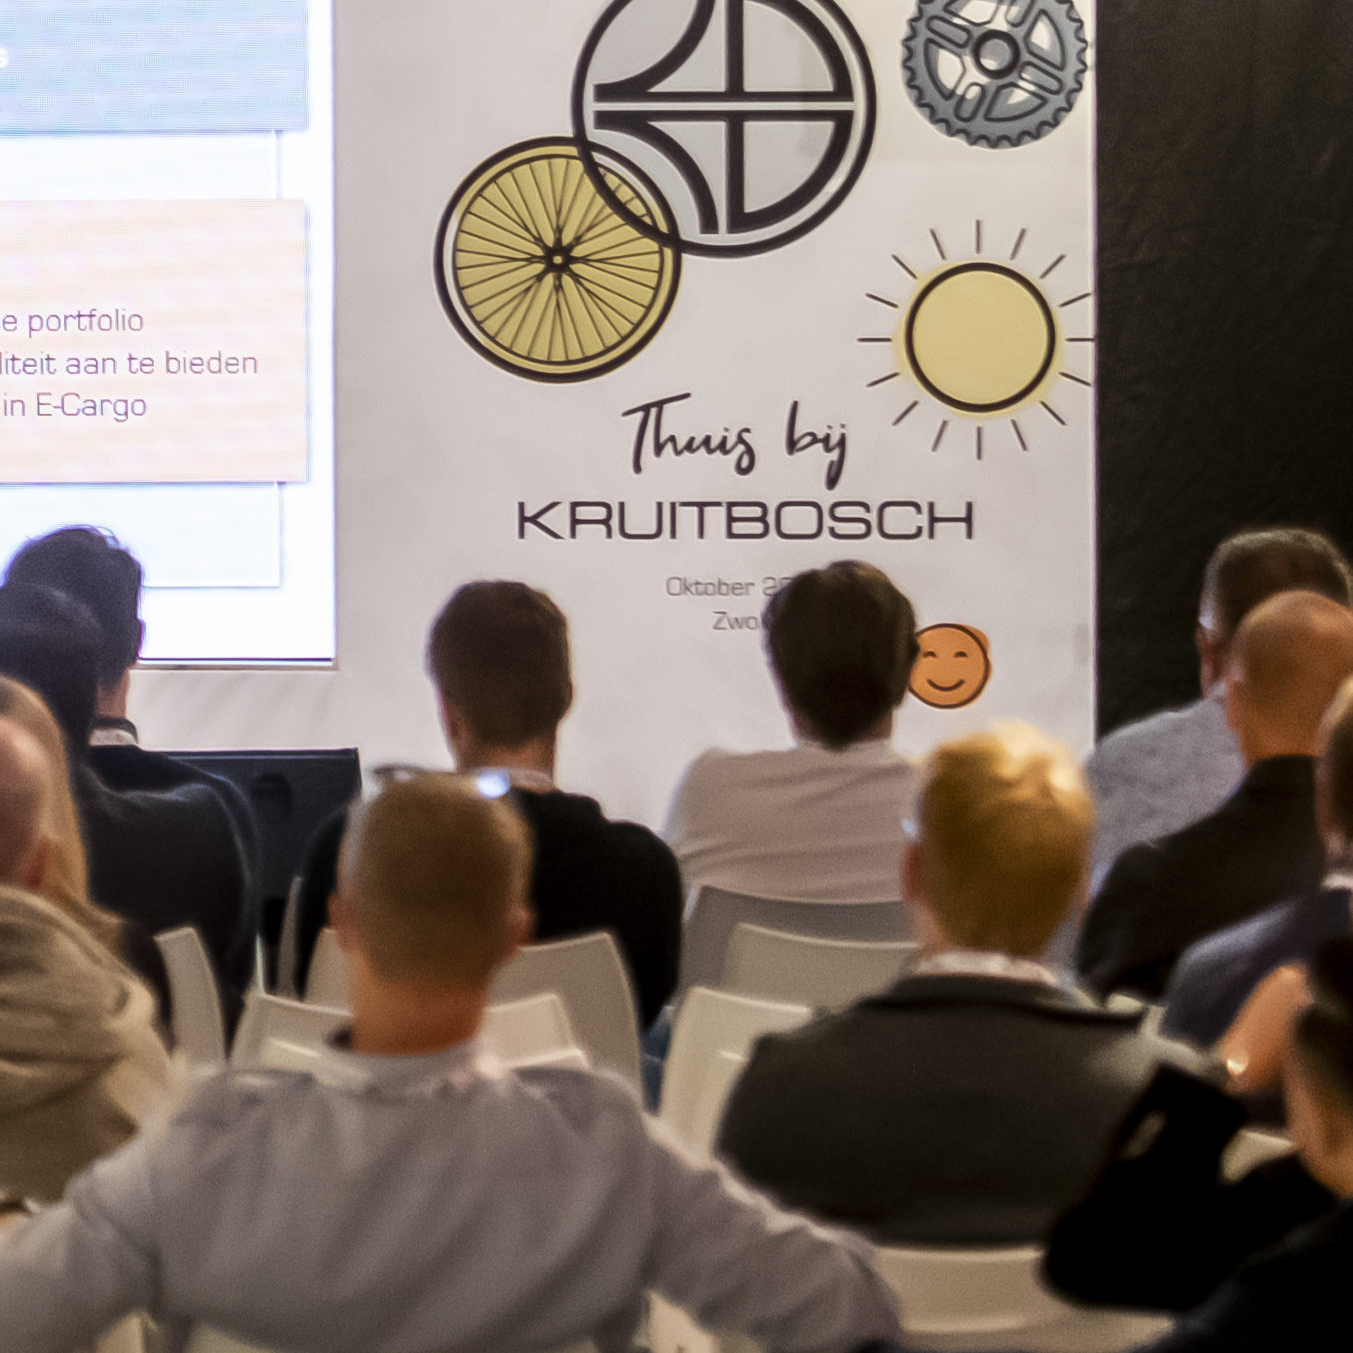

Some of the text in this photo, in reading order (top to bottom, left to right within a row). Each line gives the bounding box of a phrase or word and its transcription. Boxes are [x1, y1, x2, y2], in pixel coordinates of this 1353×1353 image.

[29, 309, 143, 338] portfolio
[66, 358, 116, 374] aan
[127, 354, 154, 374] te
[166, 351, 257, 374] bieden
[3, 394, 26, 417] in
[37, 392, 146, 422] E-Cargo
[622, 392, 847, 490] Thuis bij
[517, 501, 974, 540] KRUITBOSCH
[666, 576, 755, 597] Oktober
